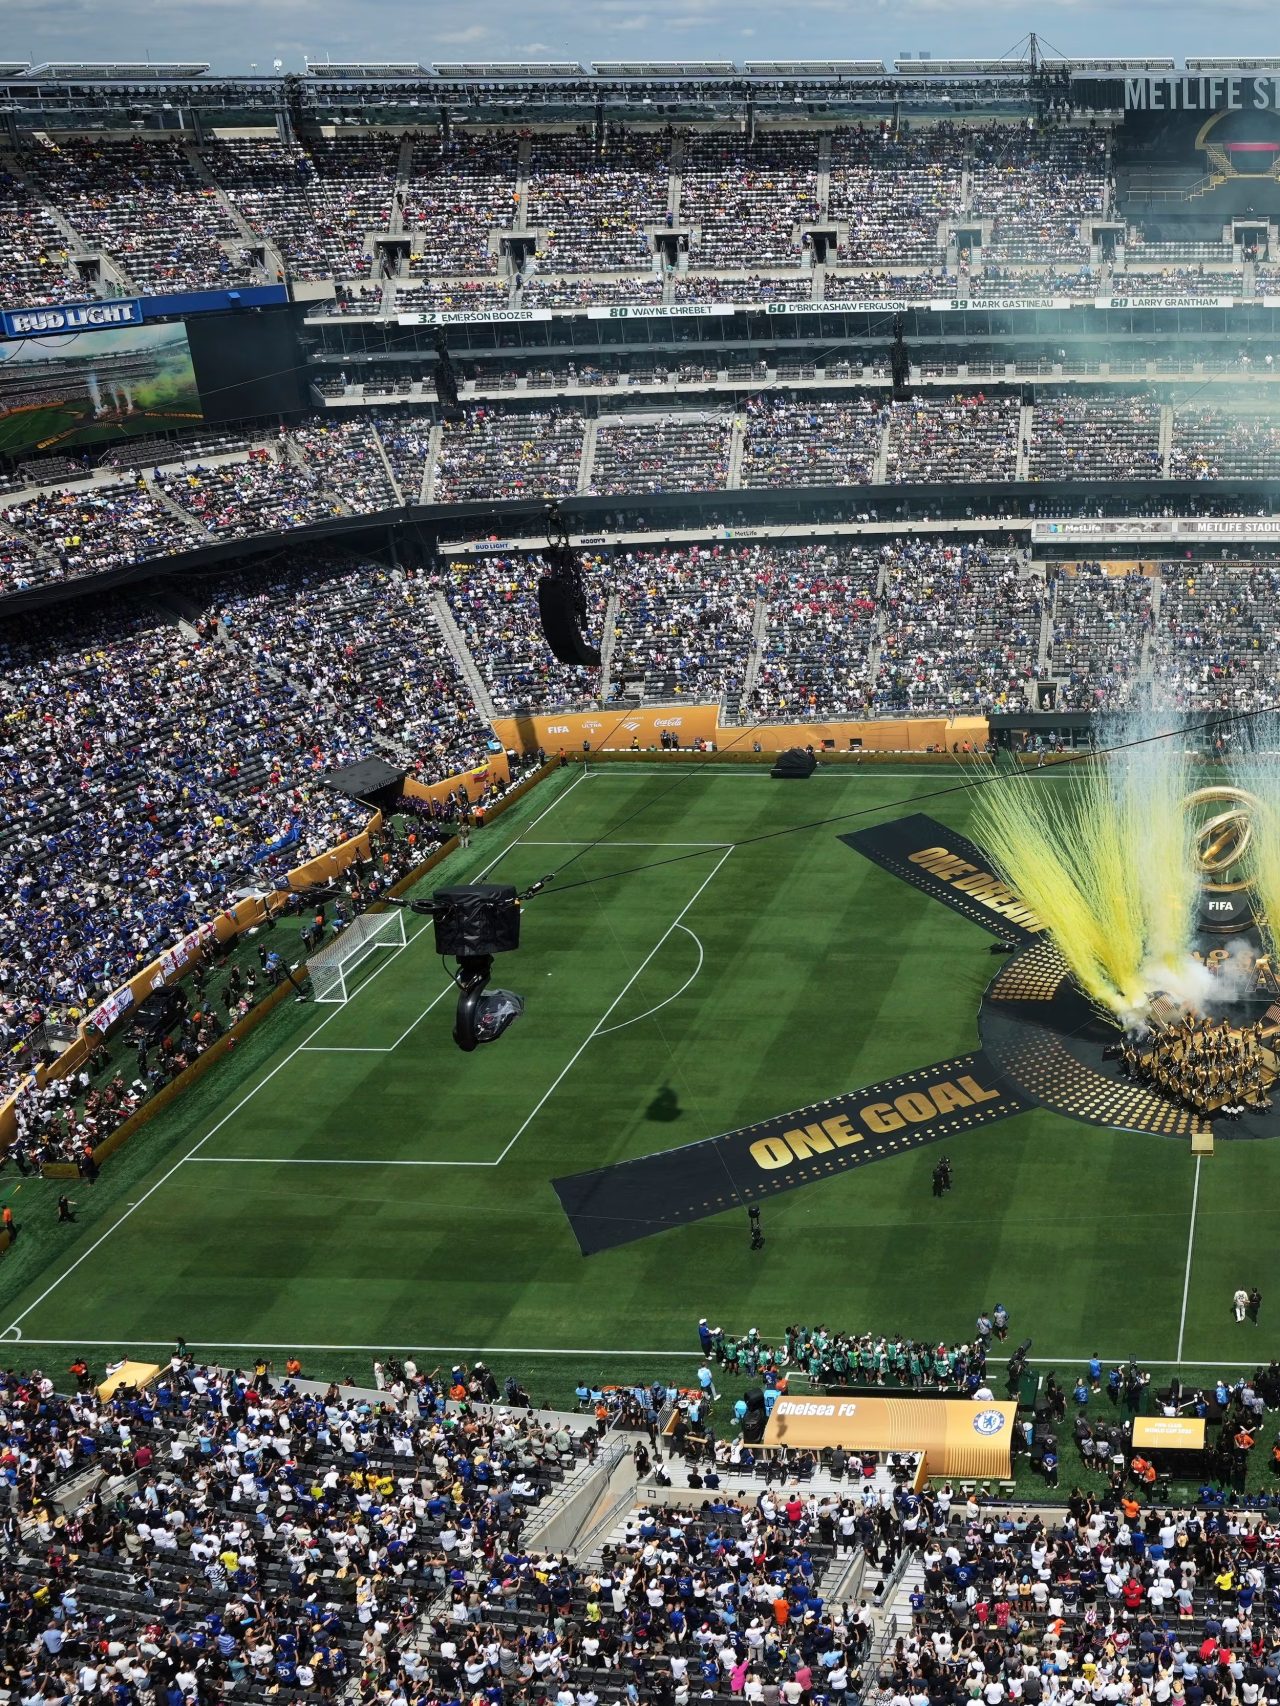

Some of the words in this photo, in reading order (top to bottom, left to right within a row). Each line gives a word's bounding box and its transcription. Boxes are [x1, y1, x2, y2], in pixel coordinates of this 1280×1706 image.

[1124, 77, 1243, 109] METLIFE
[768, 303, 786, 313] 60
[789, 302, 858, 313] D'BRICKASHAW
[859, 301, 906, 311] FERGUSON
[950, 300, 968, 309] 99
[972, 300, 1000, 309] MARK
[1002, 299, 1054, 308] GASTINEAU
[1110, 298, 1129, 307] 60
[1132, 298, 1163, 307] LARRY
[1164, 297, 1219, 307] GRANTHAM
[609, 307, 628, 317] 80
[631, 307, 668, 316] WAYNE
[669, 306, 713, 315] CHREBET
[12, 310, 65, 332] BUD
[67, 303, 136, 326] LIGHT
[418, 313, 436, 323] 32
[441, 312, 491, 323] EMERSON
[492, 311, 533, 321] BOOZER
[1065, 524, 1101, 532] MetLife
[1197, 522, 1243, 532] METLIFE
[734, 530, 758, 538] MetLife
[490, 542, 509, 550] LIGHT
[548, 726, 570, 734] FIFA
[908, 847, 979, 881] ONE
[1208, 901, 1233, 911] FIFA
[749, 1114, 865, 1170] ONE
[859, 1075, 1001, 1134] GOAL
[777, 1402, 834, 1416] Chelsea
[838, 1403, 856, 1417] FC
